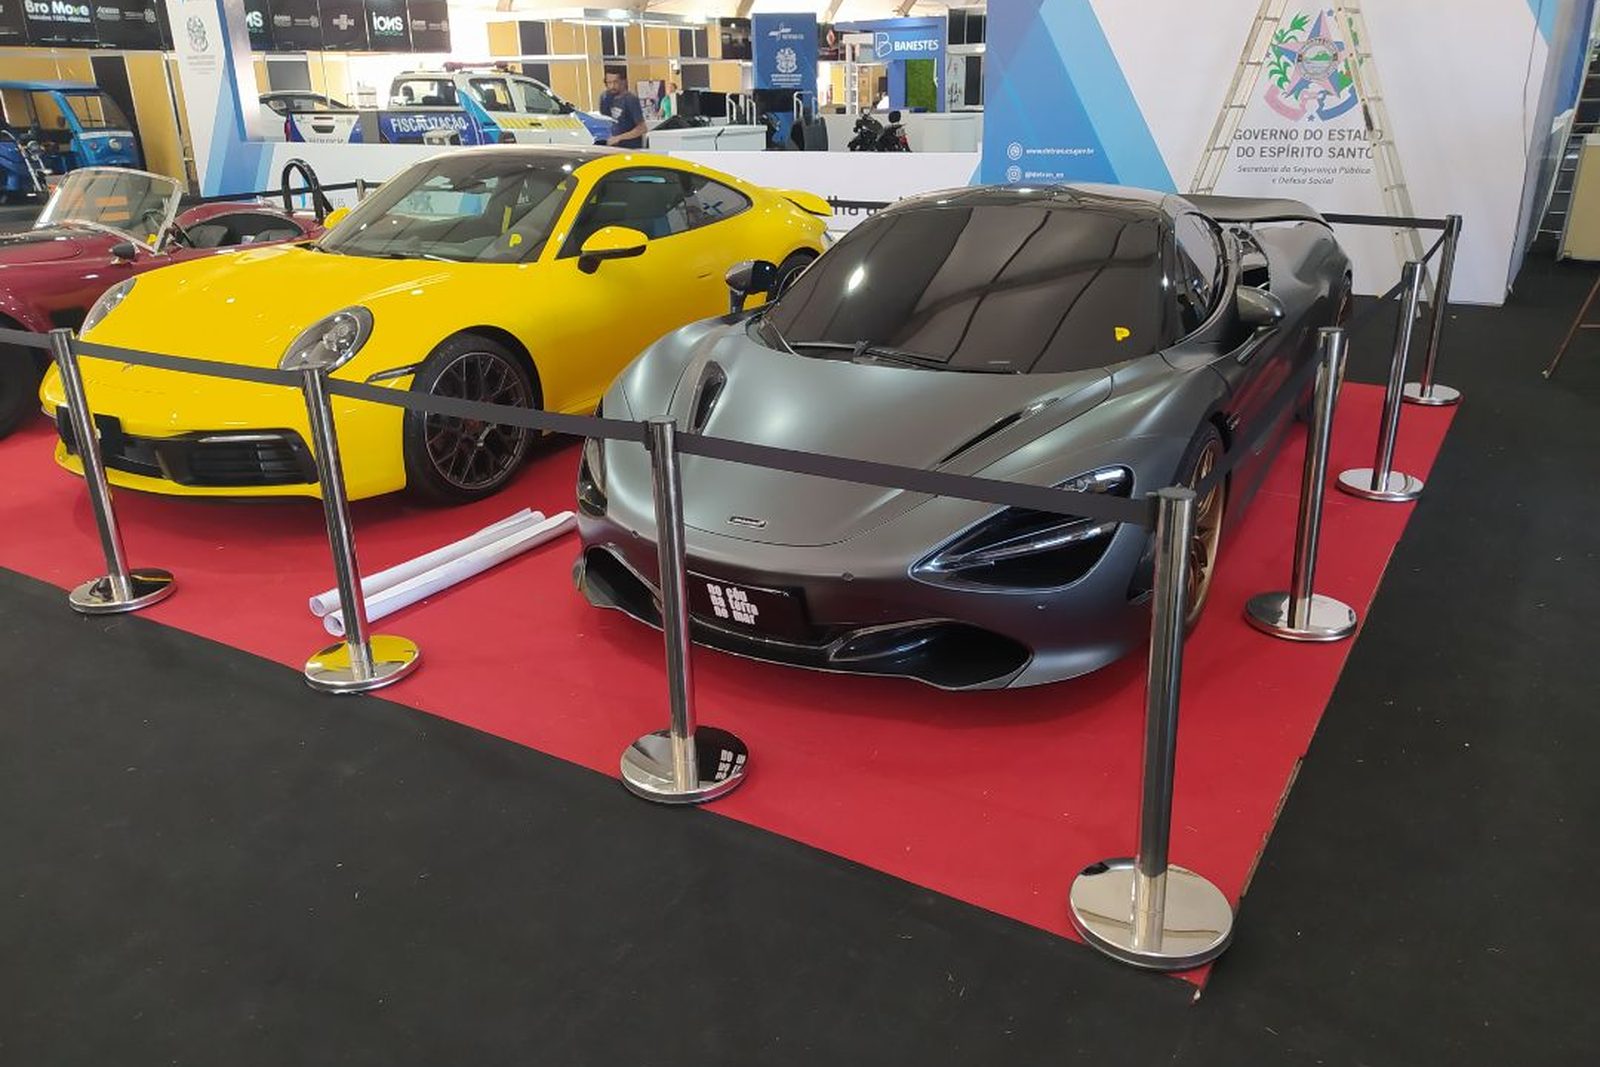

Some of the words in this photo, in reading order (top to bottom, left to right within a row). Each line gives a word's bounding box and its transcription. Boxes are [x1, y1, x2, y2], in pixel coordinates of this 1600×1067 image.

[52, 1, 90, 16] Move
[894, 39, 939, 51] BANESTES
[1233, 128, 1299, 141] GOVERNO
[1304, 128, 1324, 141] DO
[1236, 146, 1256, 158] DO
[1260, 143, 1324, 158] ESPÍRITO
